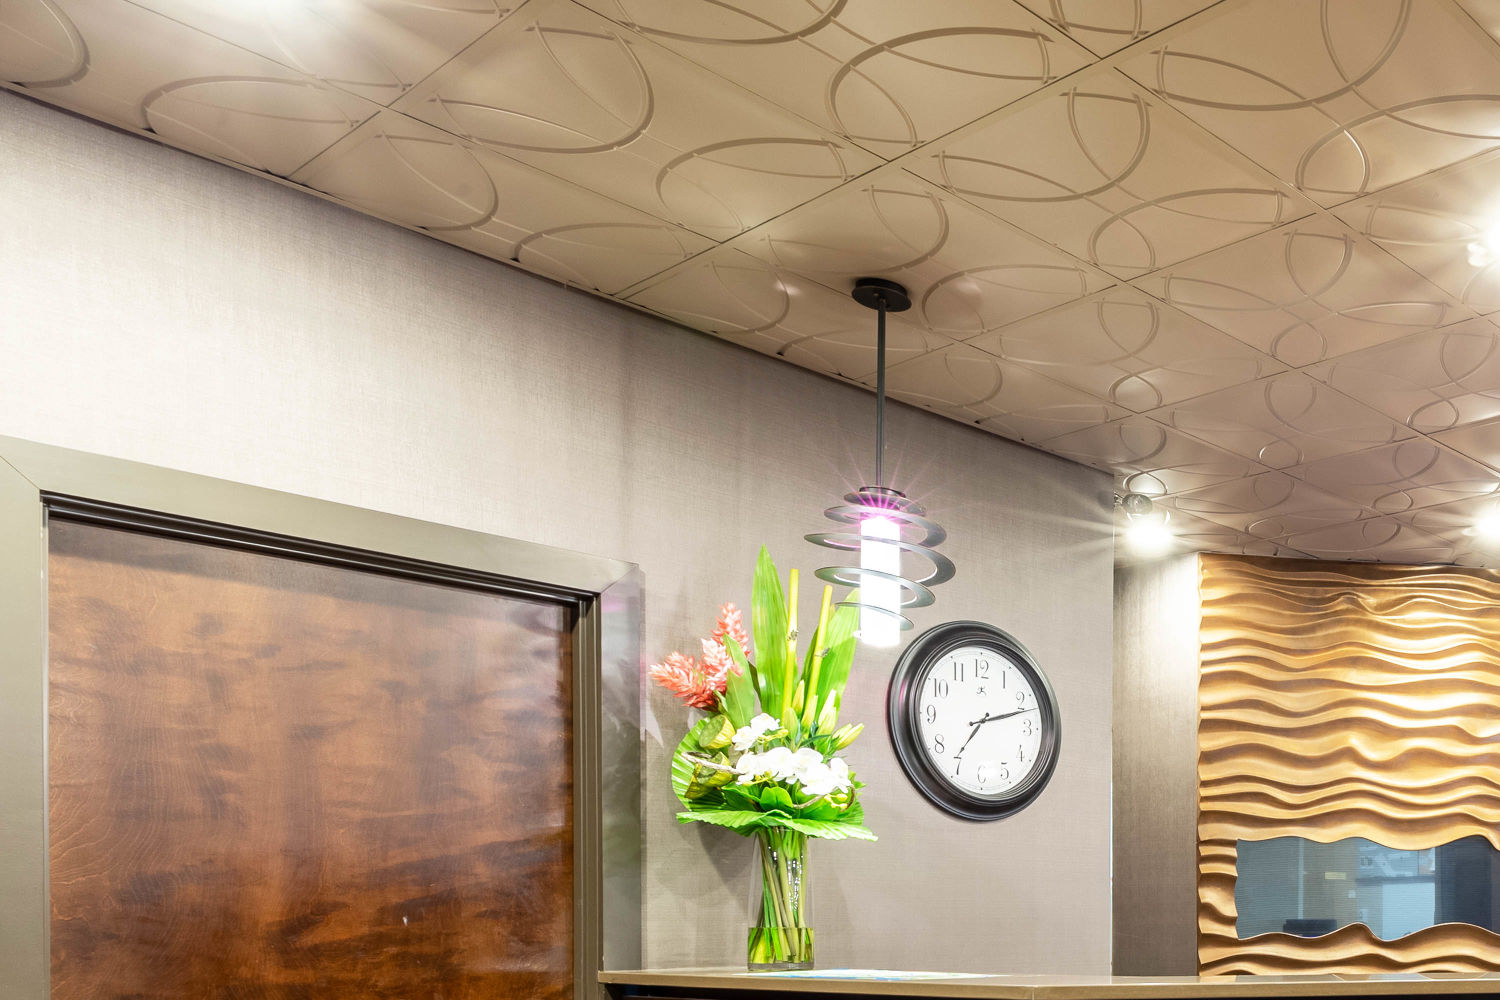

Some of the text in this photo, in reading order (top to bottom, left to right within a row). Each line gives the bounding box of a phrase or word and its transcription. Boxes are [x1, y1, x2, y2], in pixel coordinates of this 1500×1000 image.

[953, 662, 964, 682] 11
[975, 658, 989, 679] 12
[934, 678, 948, 698] 10
[1002, 670, 1006, 689] 1
[1016, 691, 1025, 710] 2
[926, 704, 936, 724] 9
[1023, 719, 1032, 736] 3
[934, 733, 945, 754] 8
[1016, 744, 1025, 762] 4
[953, 755, 962, 775] 7
[1000, 762, 1009, 780] 5
